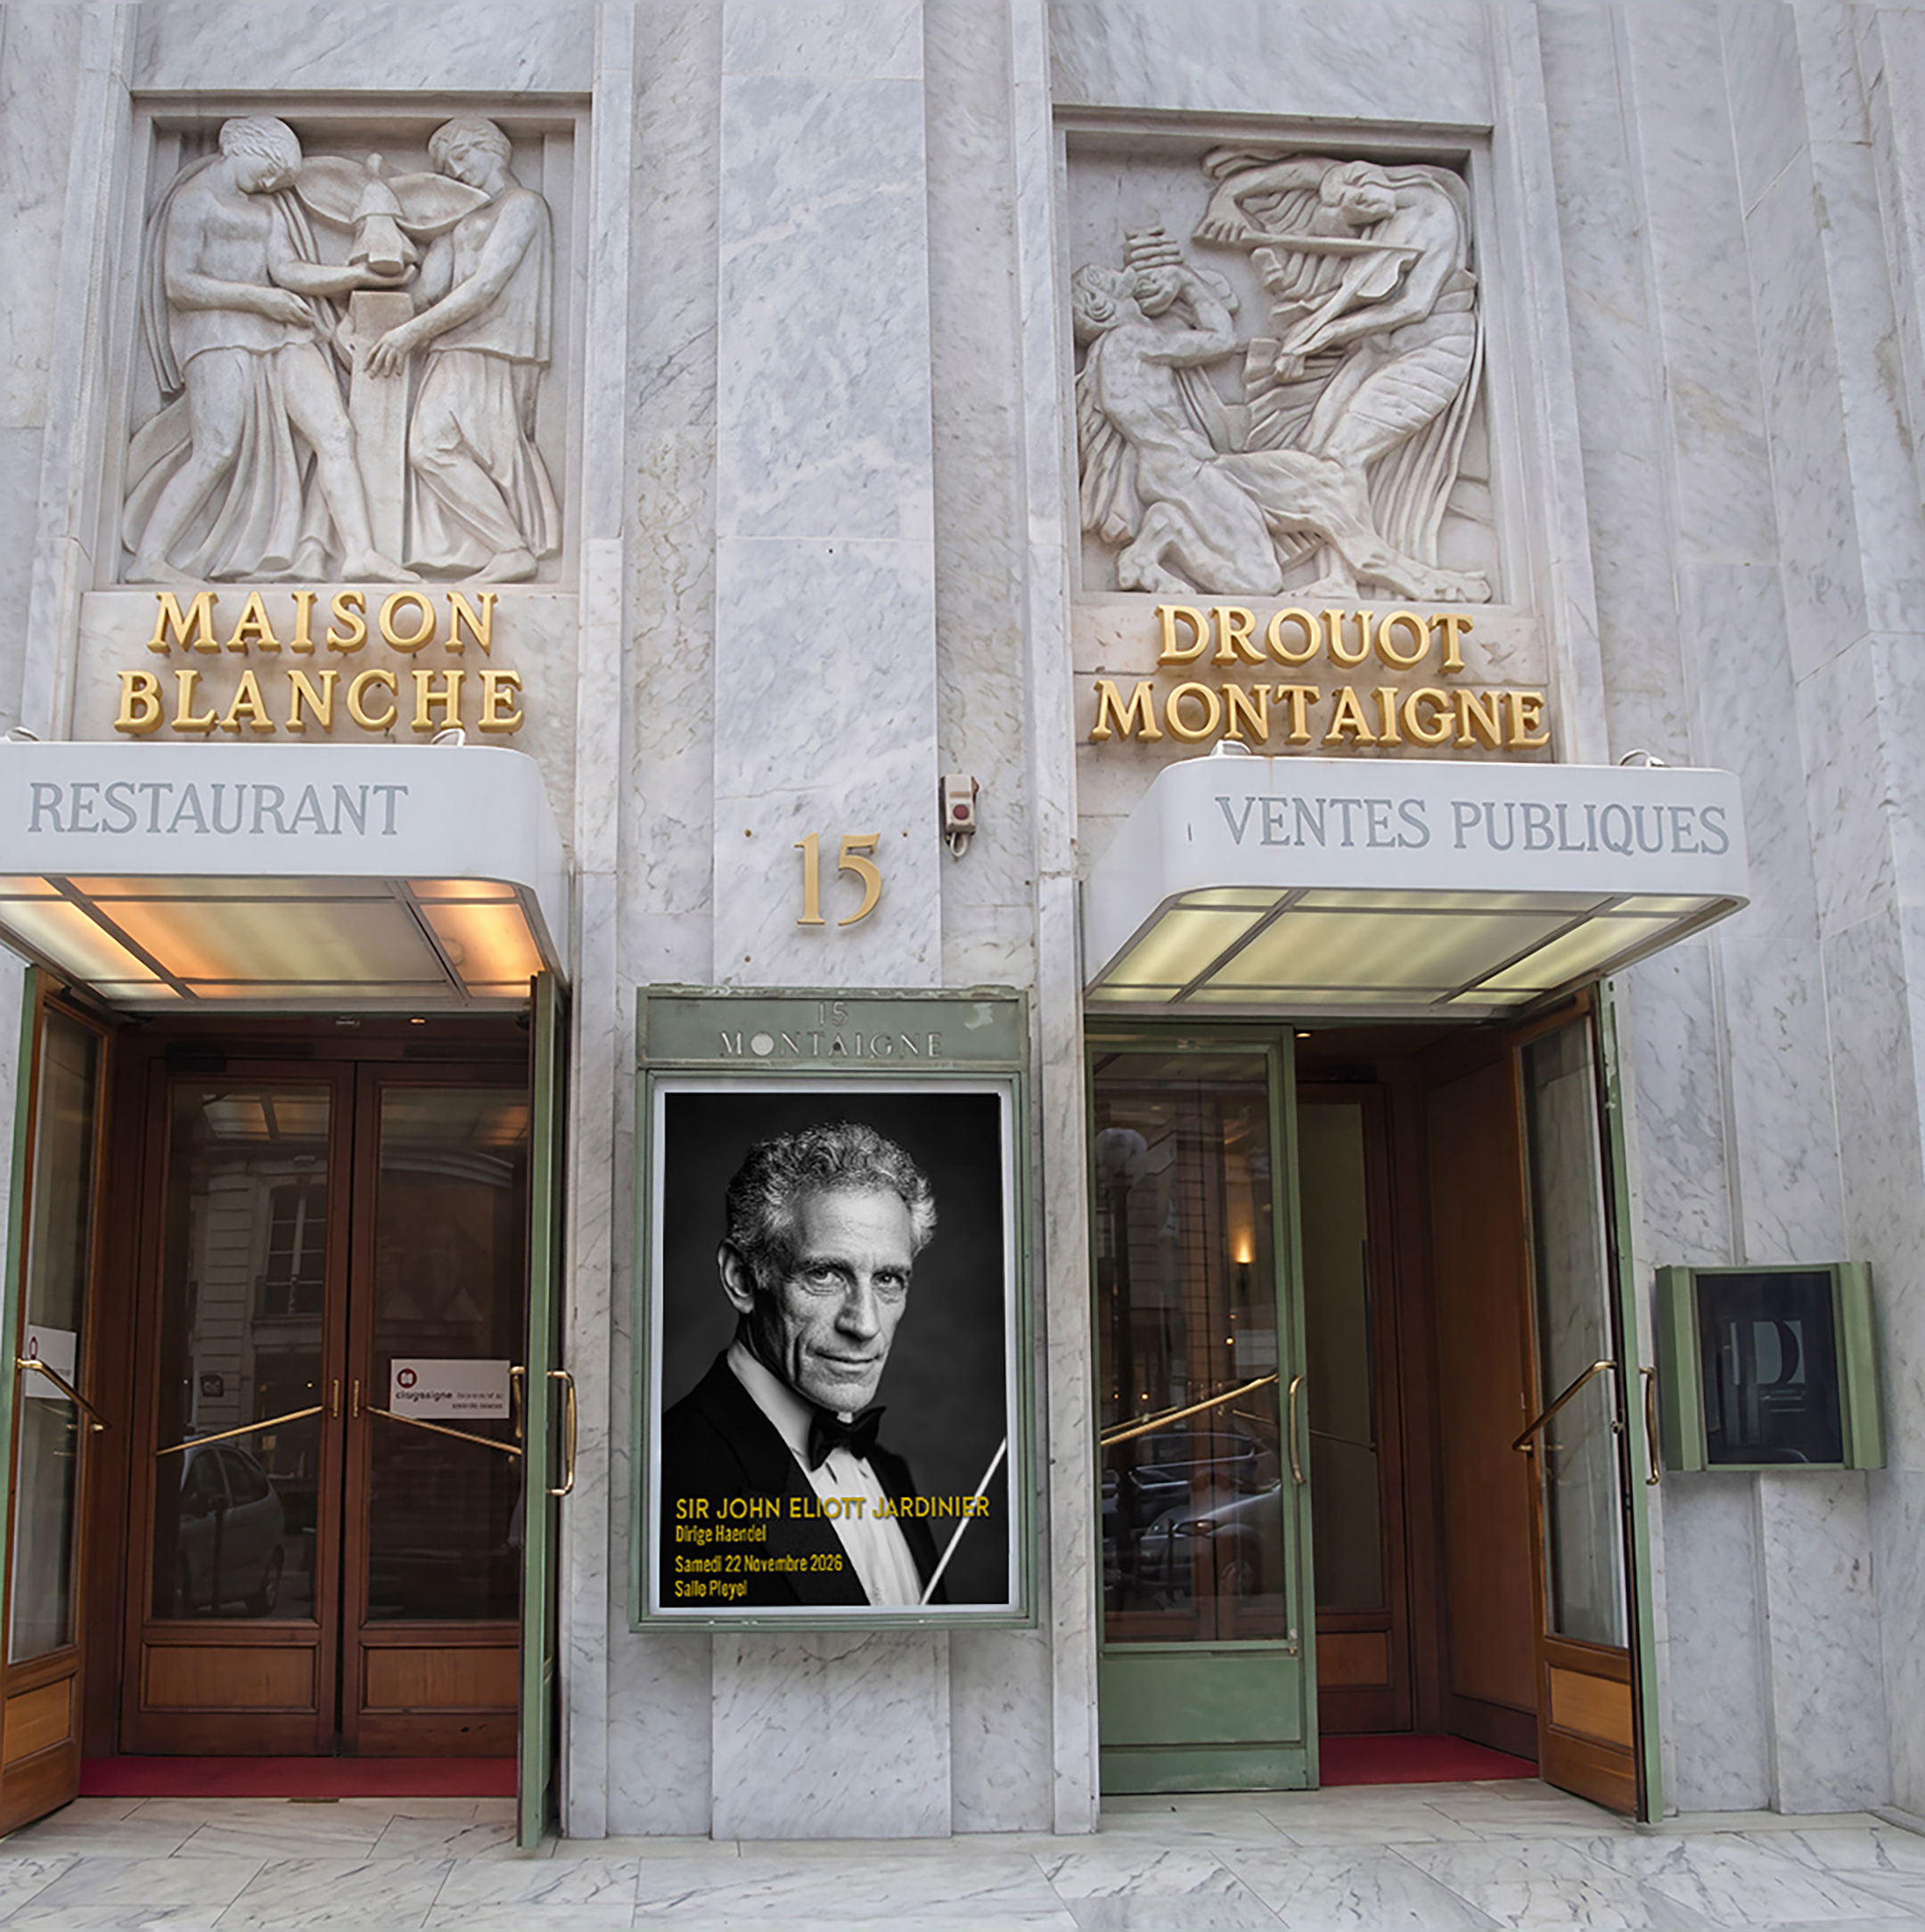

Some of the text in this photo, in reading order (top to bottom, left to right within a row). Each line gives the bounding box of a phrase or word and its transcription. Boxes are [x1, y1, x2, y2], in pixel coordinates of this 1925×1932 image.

[147, 592, 497, 655] MAISON
[1156, 605, 1473, 674] DROUOT
[114, 669, 524, 733] BLANCHE
[1089, 681, 1550, 750] MONTAIGNE
[28, 782, 408, 835] RESTAURANT
[1216, 798, 1731, 855] VENTES PUBLIQUES
[794, 832, 881, 926] 15
[818, 1002, 848, 1027] 15
[720, 1031, 942, 1057] MONTAIGNE
[676, 1496, 989, 1519] SIR JOHN ELIOTT JARDINIER
[676, 1524, 766, 1546] Dirige Haendel
[675, 1553, 843, 1572] Samedi 22 Novembre 2026
[675, 1579, 748, 1600] Salle Pleyel
